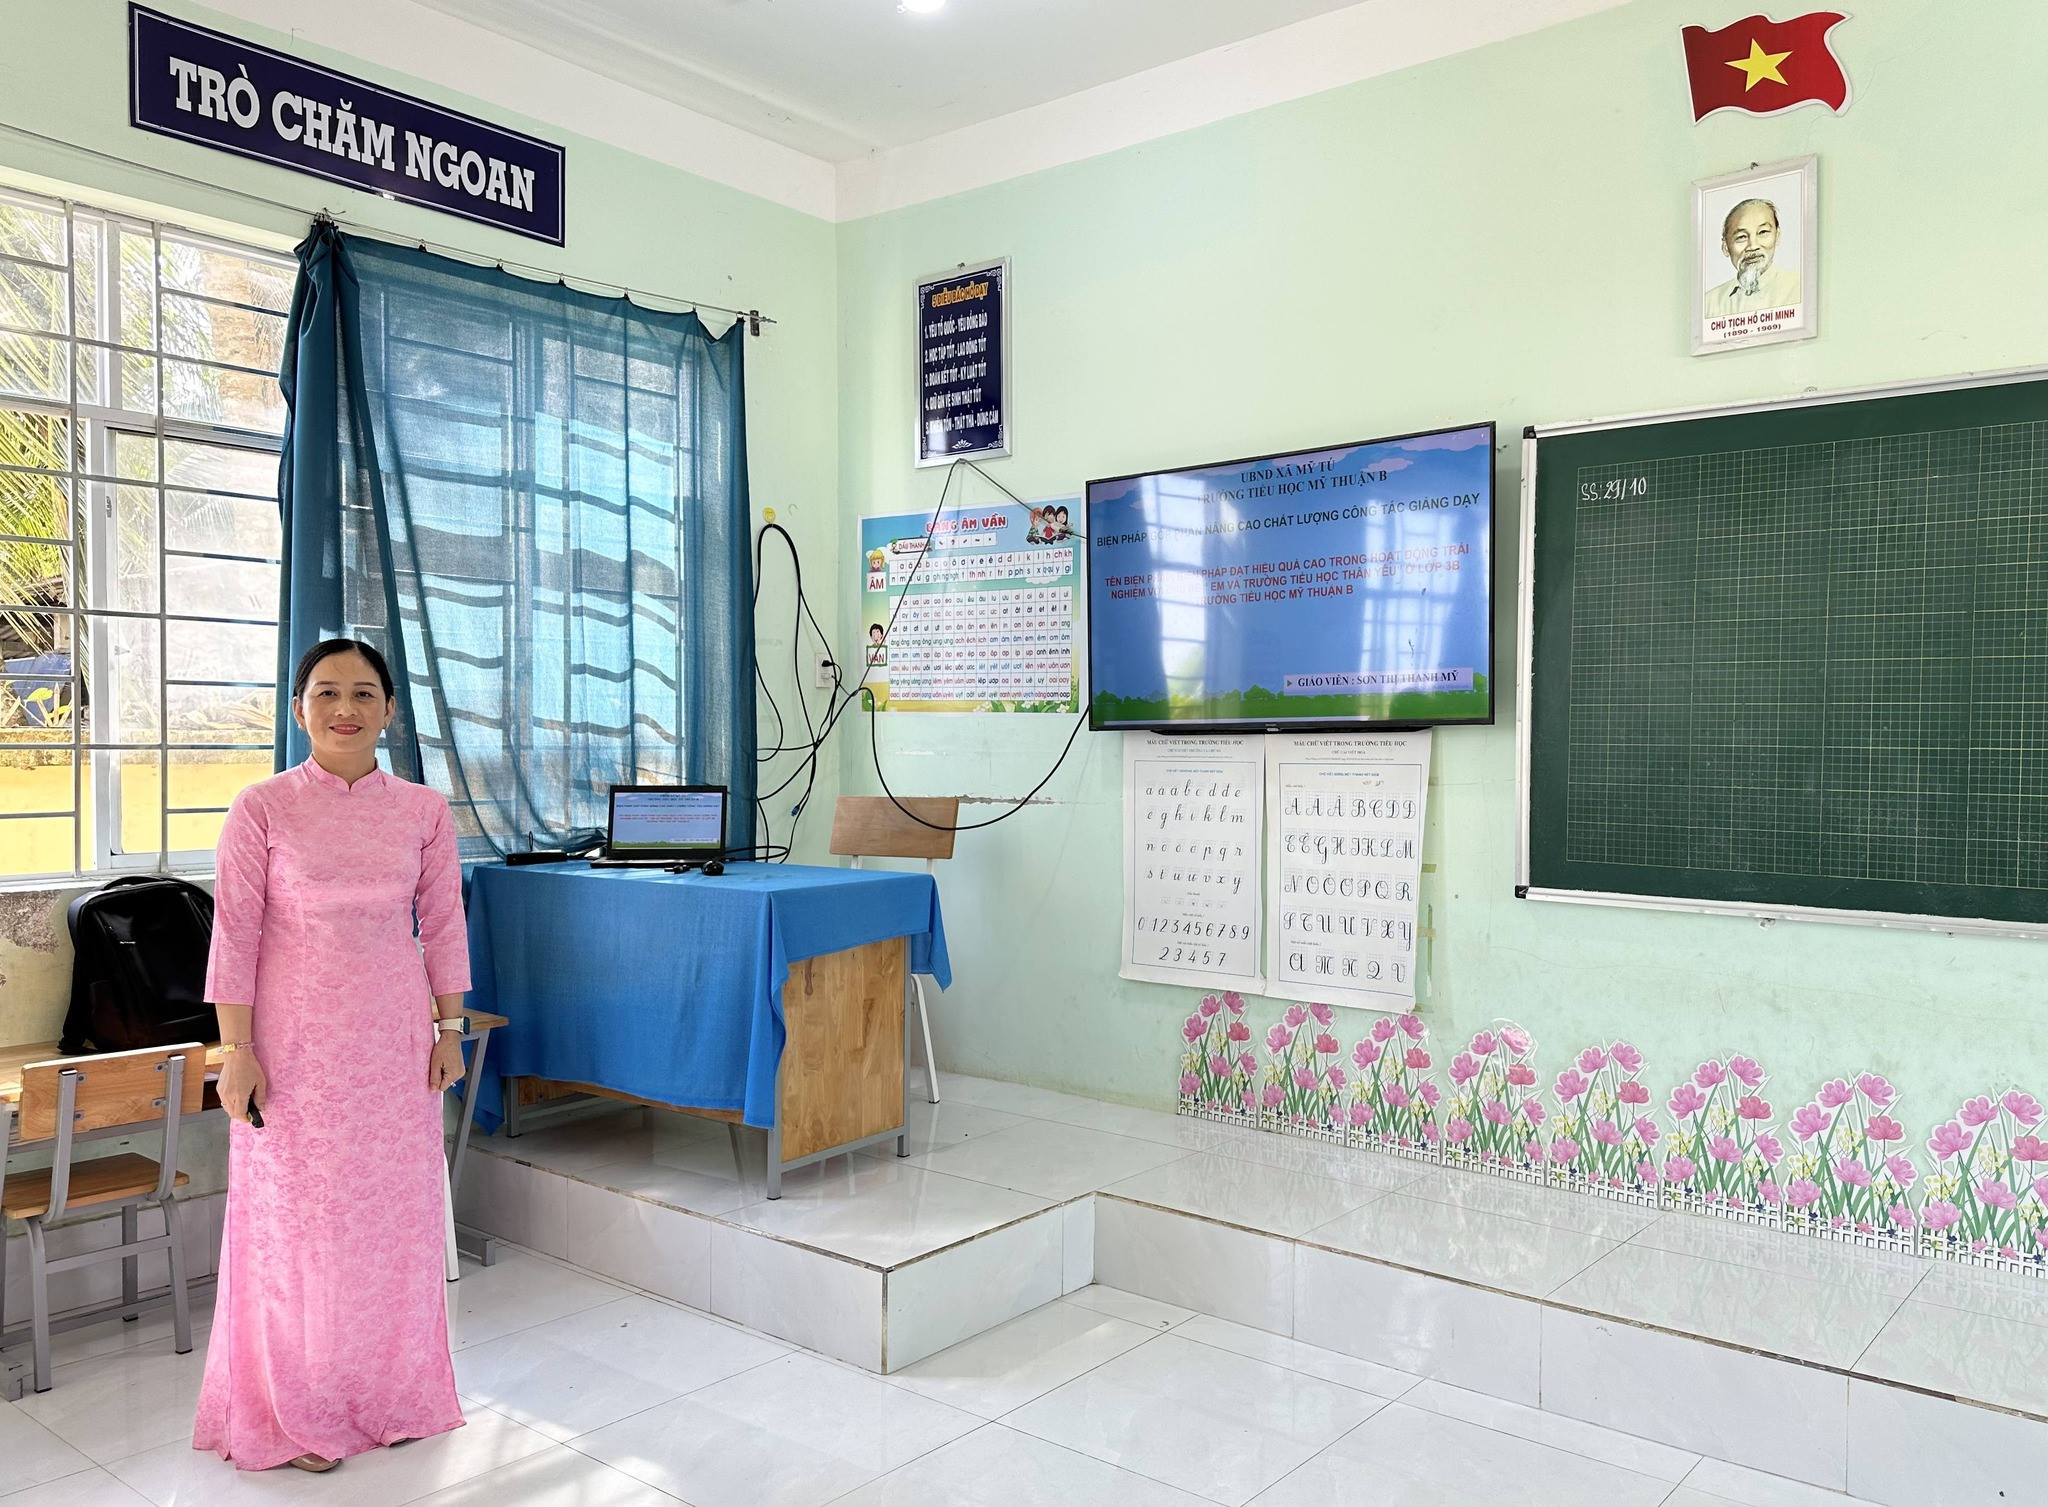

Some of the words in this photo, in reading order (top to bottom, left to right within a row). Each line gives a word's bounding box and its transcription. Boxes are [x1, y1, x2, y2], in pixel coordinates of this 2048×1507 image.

[169, 56, 260, 129] TRÒ
[272, 90, 395, 172] CHĂM
[404, 131, 536, 213] NGOAN
[1711, 317, 1726, 331] CHỦ
[1728, 318, 1746, 330] TỊCH
[1748, 312, 1758, 324] HỒ
[1760, 310, 1773, 323] CHÍ
[1775, 309, 1795, 320] MINH
[1724, 329, 1748, 338] (1890
[1757, 324, 1781, 333] 1969)
[1241, 468, 1273, 483] UBND
[1275, 464, 1292, 480] XÃ
[1295, 461, 1316, 475] MỸ
[1318, 457, 1336, 472] TÚ
[1278, 481, 1304, 496] HỌC
[1307, 476, 1327, 492] MỸ
[1379, 470, 1387, 481] B
[961, 517, 978, 530] ÂM
[1097, 534, 1119, 548] BIỆN
[1121, 530, 1147, 545] PHÁP
[1238, 519, 1261, 531] CAO
[1297, 510, 1339, 525] LƯỢNG
[1382, 500, 1405, 515] TÁC
[1453, 493, 1480, 508] DẠY
[1304, 558, 1326, 569] CAO
[1330, 554, 1367, 567] TRONG
[869, 577, 884, 590] ÂM
[1199, 594, 1236, 606] RƯỜNG
[1347, 585, 1354, 594] B
[1298, 675, 1323, 687] GIÁO
[1324, 674, 1349, 686] VIÊN
[1357, 675, 1378, 685] SƠN
[1380, 674, 1398, 685] THỊ
[1400, 673, 1438, 683] THANH
[1441, 670, 1459, 682] MỸ
[1138, 917, 1146, 931] 0
[1152, 918, 1158, 932] 1
[1160, 919, 1168, 932] 2
[1172, 920, 1180, 934] 3
[1183, 922, 1191, 935] 4
[1194, 922, 1203, 936] 5
[1206, 923, 1214, 937] 6
[1217, 924, 1226, 938] 7
[1229, 925, 1237, 939] 8
[1241, 926, 1250, 940] 9
